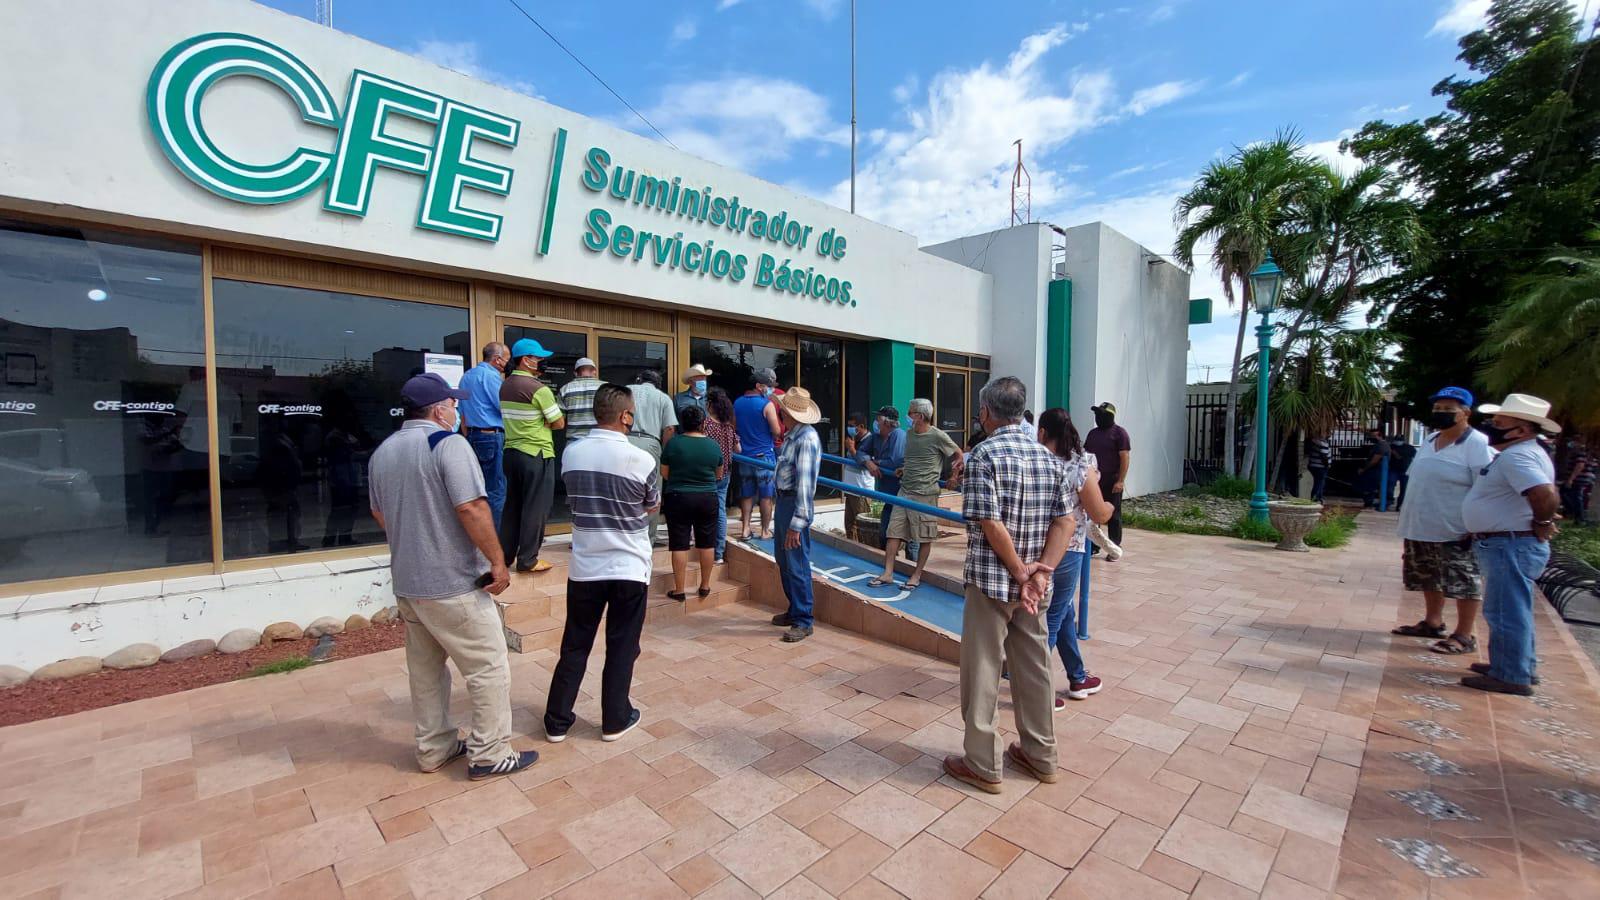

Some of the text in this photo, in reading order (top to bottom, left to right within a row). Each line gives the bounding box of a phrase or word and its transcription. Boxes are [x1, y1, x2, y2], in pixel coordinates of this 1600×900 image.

[147, 32, 521, 243] CFE
[582, 147, 848, 260] Suministrador de
[583, 208, 857, 308] Servicios Básicos.
[93, 400, 175, 411] CFE-contigo
[258, 404, 322, 414] CFE-contigo
